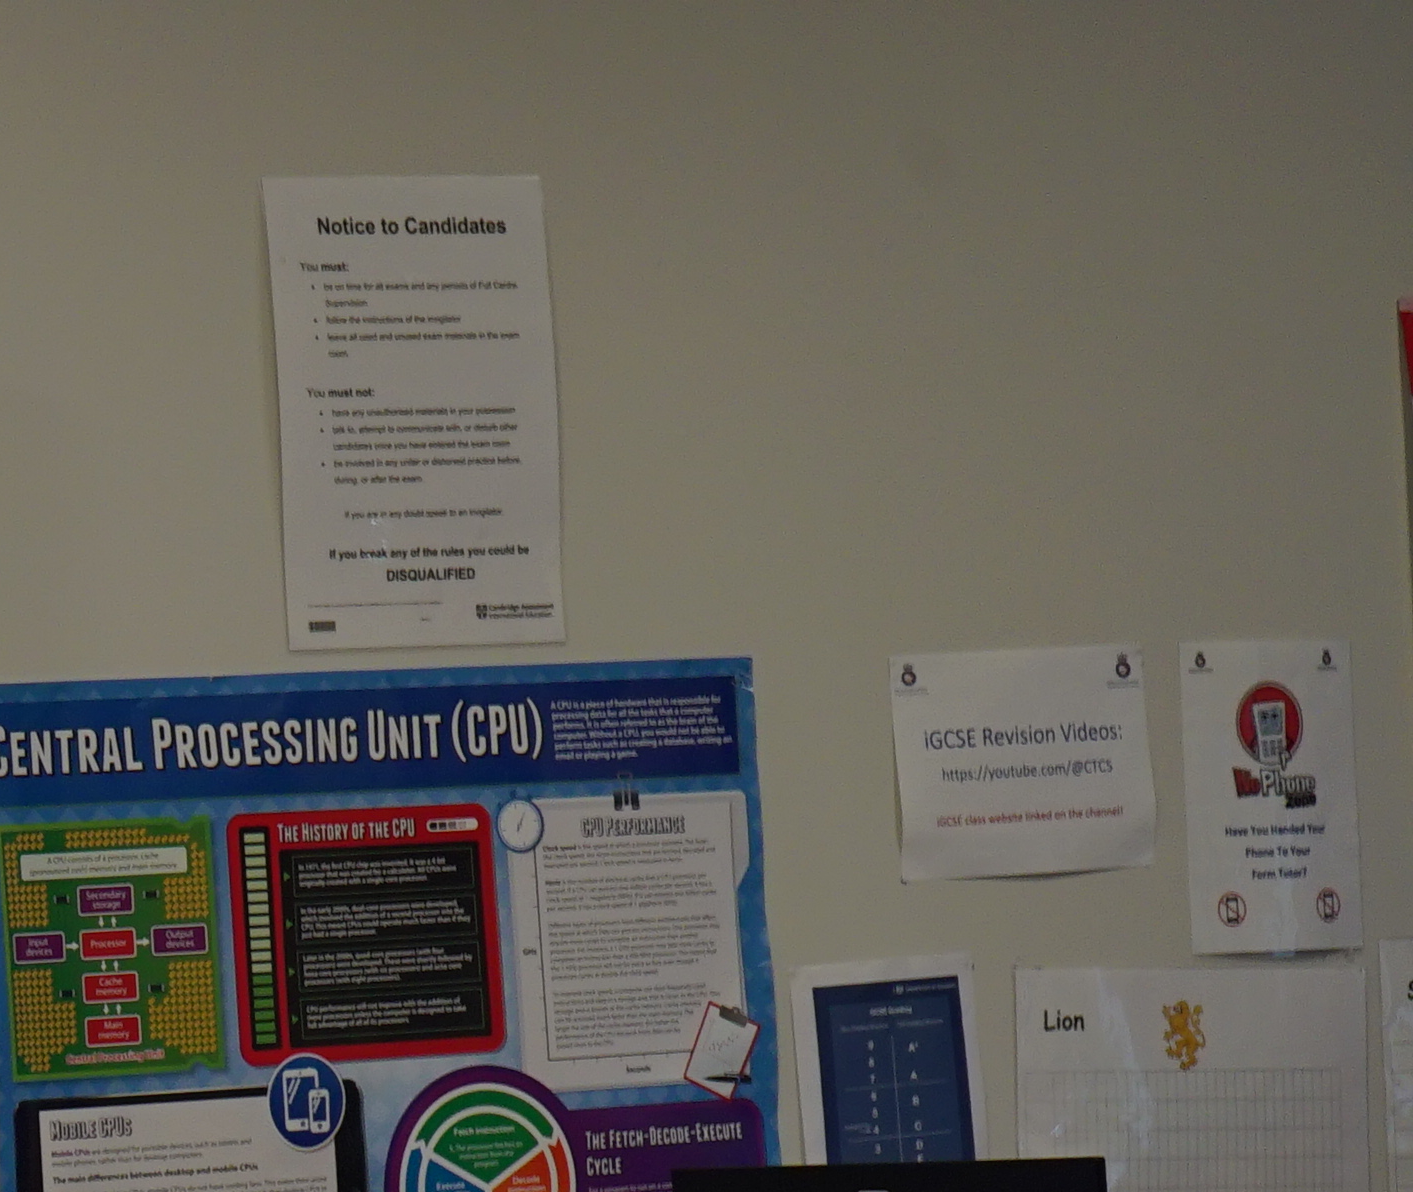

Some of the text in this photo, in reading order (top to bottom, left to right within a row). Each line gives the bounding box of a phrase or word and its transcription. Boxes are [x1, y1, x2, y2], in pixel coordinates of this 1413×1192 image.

[316, 216, 507, 236] Notice to Candidates
[306, 387, 376, 399] You must not:
[385, 567, 476, 583] DISQUALIFIED
[150, 715, 360, 771] PROCESSING
[366, 706, 443, 763] UNIT
[450, 696, 544, 764] (CPU)
[924, 720, 1123, 751] iGCSE Revision Videos:
[276, 817, 416, 844] THE HISTORY OF THE CPU
[579, 816, 605, 839] CPU
[1042, 1008, 1085, 1033] Lion
[584, 1130, 607, 1152] THE
[585, 1155, 623, 1178] CYCLE
